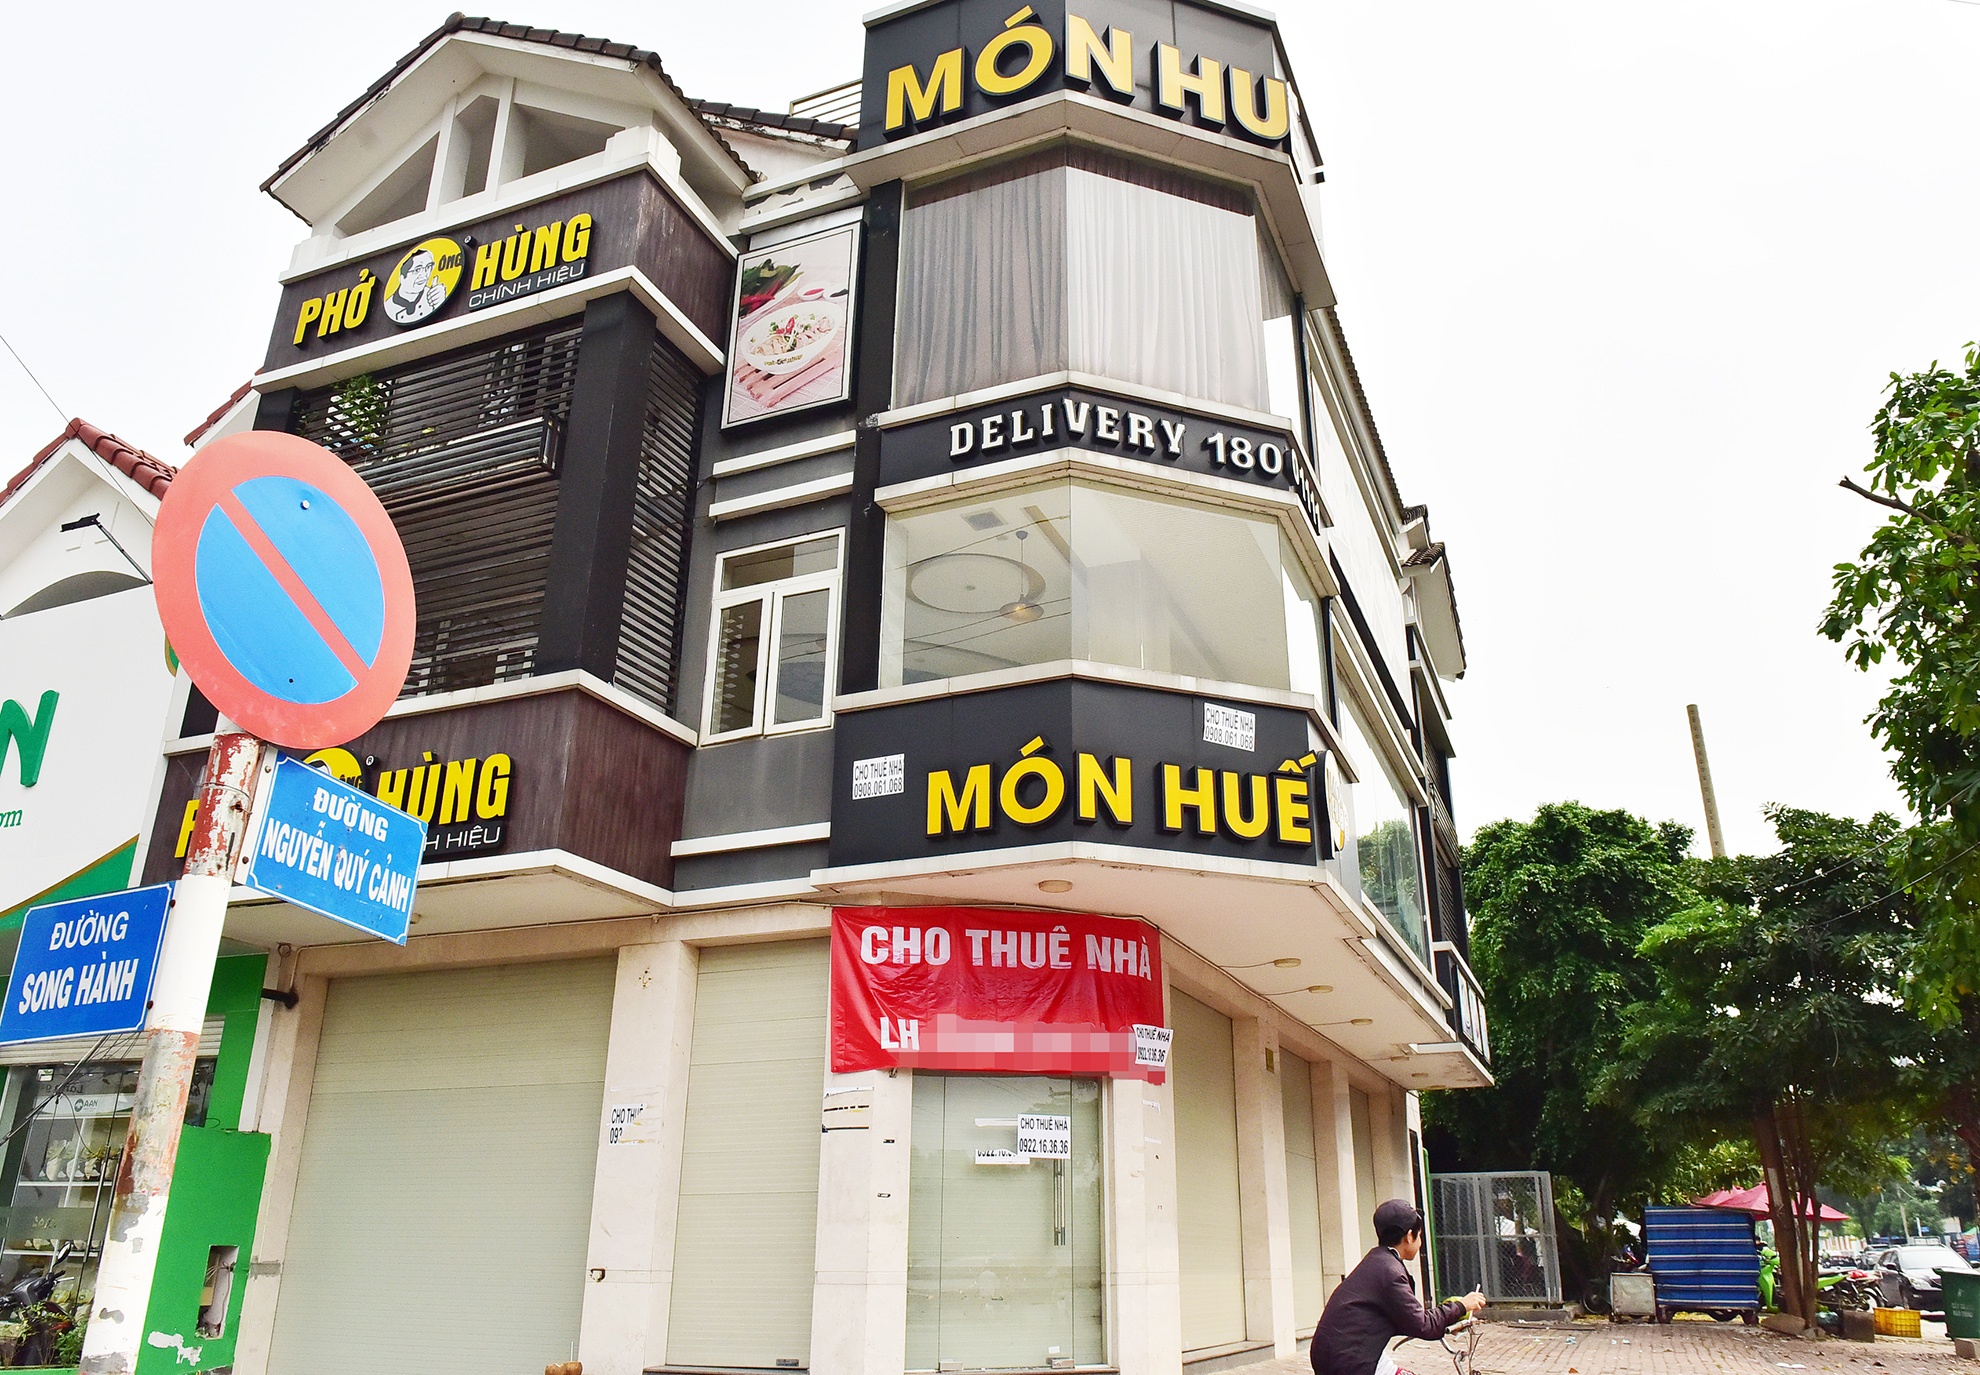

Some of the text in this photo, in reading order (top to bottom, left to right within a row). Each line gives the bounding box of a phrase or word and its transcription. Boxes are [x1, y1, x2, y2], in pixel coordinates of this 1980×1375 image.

[884, 5, 1133, 131] MÓN
[293, 268, 376, 345] PHỞ
[471, 213, 592, 291] HÙNG
[468, 263, 585, 309] CHÍNH HIỆU
[949, 398, 1187, 457] DELIVERY
[1205, 725, 1254, 750] 0908.061.068
[1206, 707, 1254, 734] CHO THUÊ NHÀ
[376, 751, 511, 825] HÙNG
[853, 777, 903, 798] 0908.061.068
[855, 754, 903, 781] CHO THUÊ NHÀ
[926, 736, 1132, 836] MÓN
[1164, 753, 1317, 844] HUẾ
[312, 786, 389, 843] ĐƯỜNG
[446, 825, 500, 849] HIỆU
[261, 817, 335, 882] NGUYỄN
[335, 846, 370, 894] QUÝ
[368, 853, 411, 913] CẢNH
[49, 910, 130, 951] ĐƯỜNG
[860, 925, 1152, 981] CHO THUÊ NHÀ
[18, 951, 139, 1015] SONG HÀNH
[880, 1016, 920, 1051] LH
[611, 1108, 626, 1124] CHO
[1020, 1116, 1068, 1131] CHO THUÊ NHÀ
[1019, 1138, 1069, 1154] 0922.16.36.36
